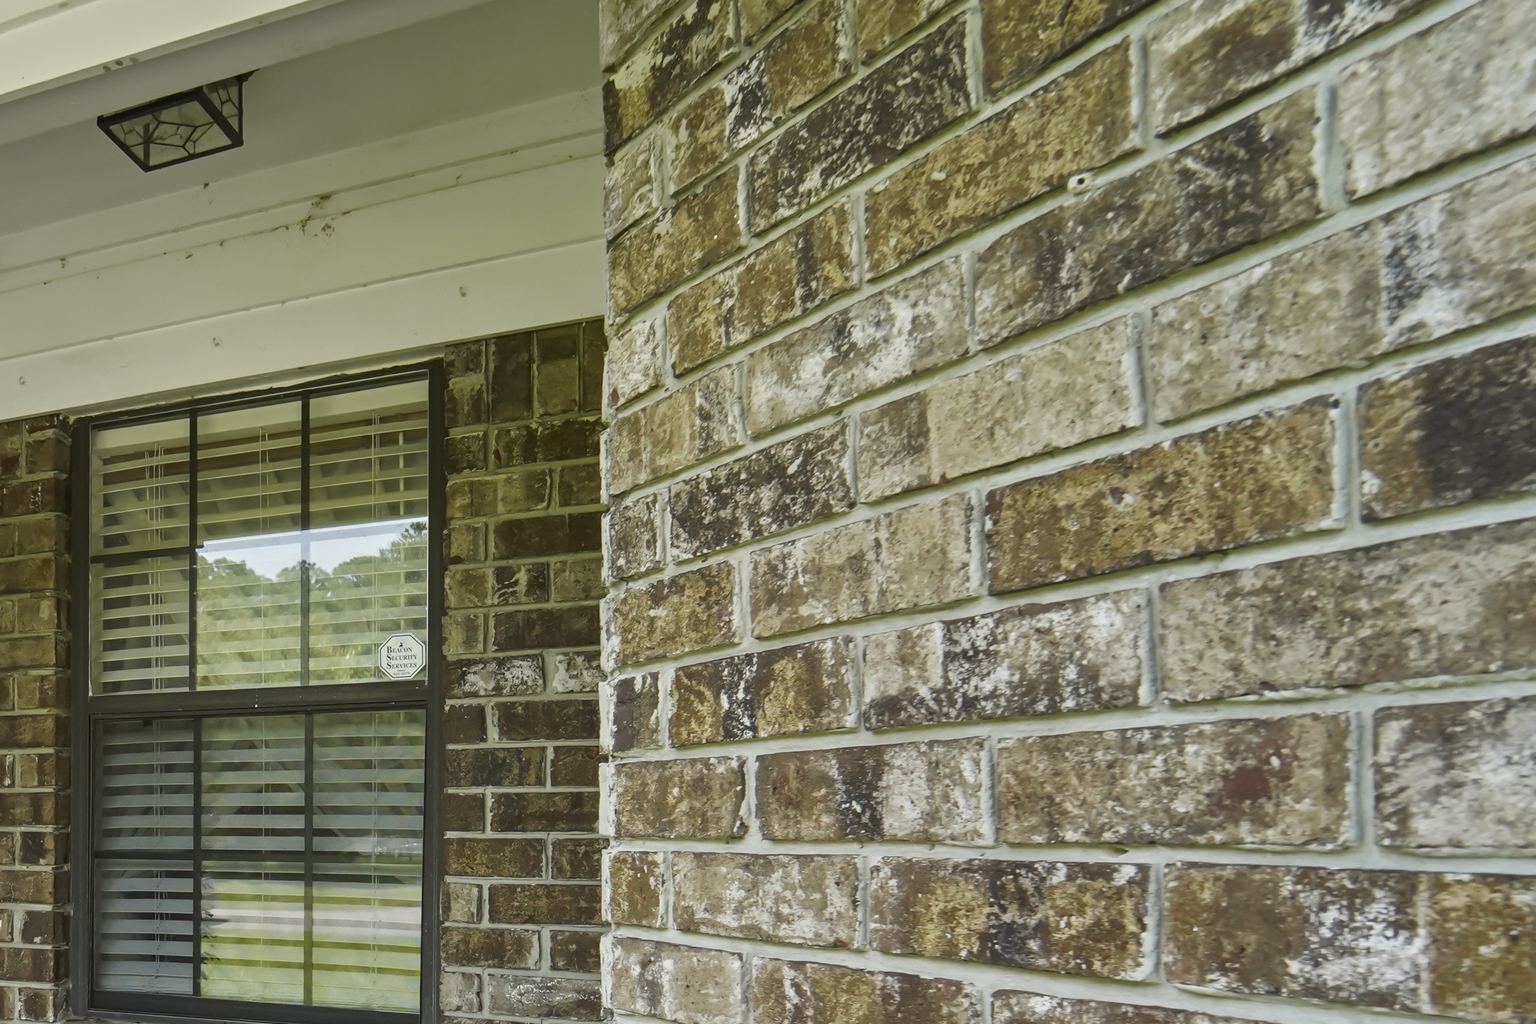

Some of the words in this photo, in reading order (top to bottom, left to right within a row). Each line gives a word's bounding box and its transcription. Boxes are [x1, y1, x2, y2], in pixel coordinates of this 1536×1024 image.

[386, 646, 413, 654] BEACON
[386, 653, 417, 662] SECURITY
[386, 661, 417, 669] SERVICES
